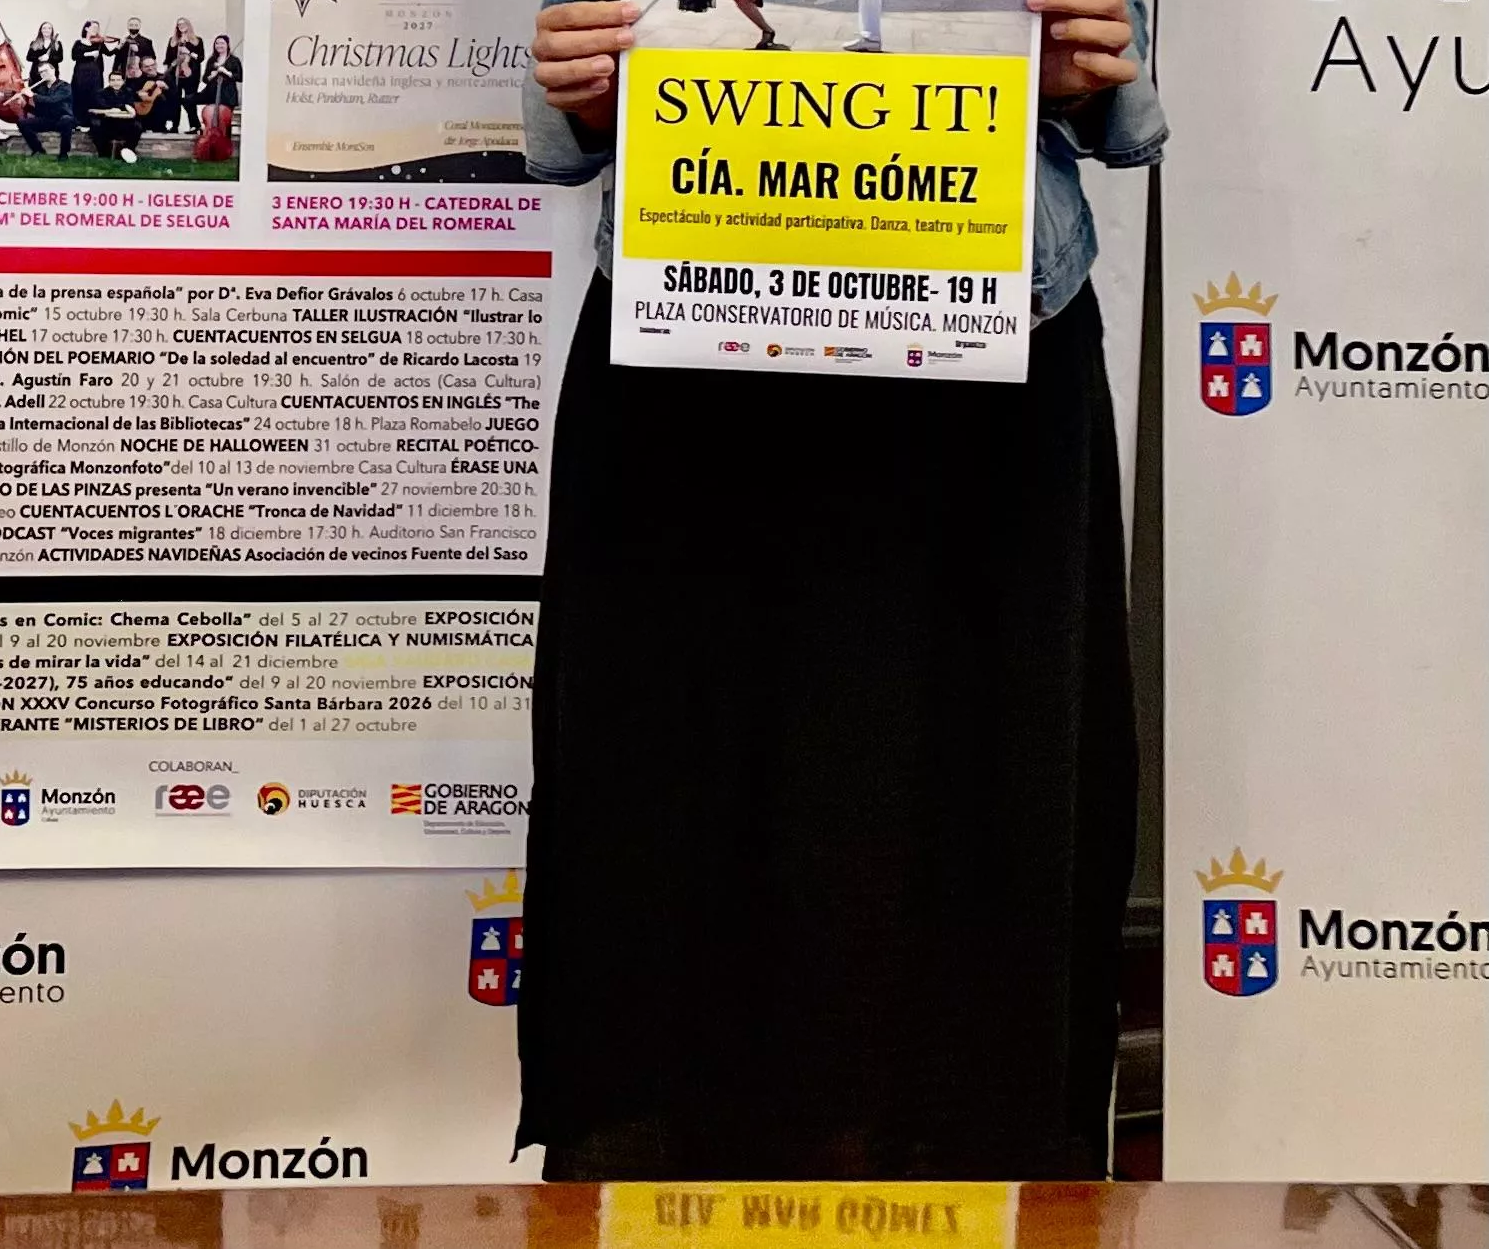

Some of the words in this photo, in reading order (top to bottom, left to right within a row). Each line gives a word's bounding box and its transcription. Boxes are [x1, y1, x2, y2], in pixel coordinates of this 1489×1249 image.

[286, 35, 438, 70] Christmas
[655, 77, 890, 131] SWING
[911, 83, 999, 134] IT!
[672, 147, 744, 198] CÍA.
[759, 160, 839, 200] MAR
[854, 153, 977, 204] GÓMEZ
[664, 260, 762, 298] SÁBADO,
[769, 270, 785, 295] 3
[793, 271, 821, 297] DE
[828, 272, 940, 301] OCTUBRE-
[946, 276, 975, 303] 19
[982, 278, 997, 305] H
[635, 300, 686, 322] PLAZA
[692, 303, 833, 329] CONSERVATORIO
[838, 309, 860, 330] DE
[865, 306, 936, 333] MÚSICA.
[942, 309, 1017, 336] MONZÓN
[1294, 331, 1489, 372] Monzón
[1295, 376, 1489, 402] Ayuntamiento
[38, 548, 143, 562] ACTIVIDADES
[148, 545, 241, 562] NAVIDEÑAS
[245, 547, 324, 562] Asociación
[329, 547, 347, 561] de
[352, 549, 407, 561] vecinos
[411, 547, 461, 561] Fuente
[466, 547, 489, 561] del
[494, 547, 528, 561] Saso
[174, 717, 200, 732] DE
[269, 716, 294, 732] del
[300, 717, 307, 732] 1
[312, 716, 327, 732] al
[331, 717, 351, 732] 27
[356, 716, 417, 732] octubre
[41, 787, 116, 805] Monzón
[298, 788, 367, 799] DIPUTACIÓN
[299, 798, 367, 808] HUESCA
[424, 783, 518, 799] GOBIERNO
[424, 801, 447, 815] DE
[170, 1136, 369, 1182] Monzón
